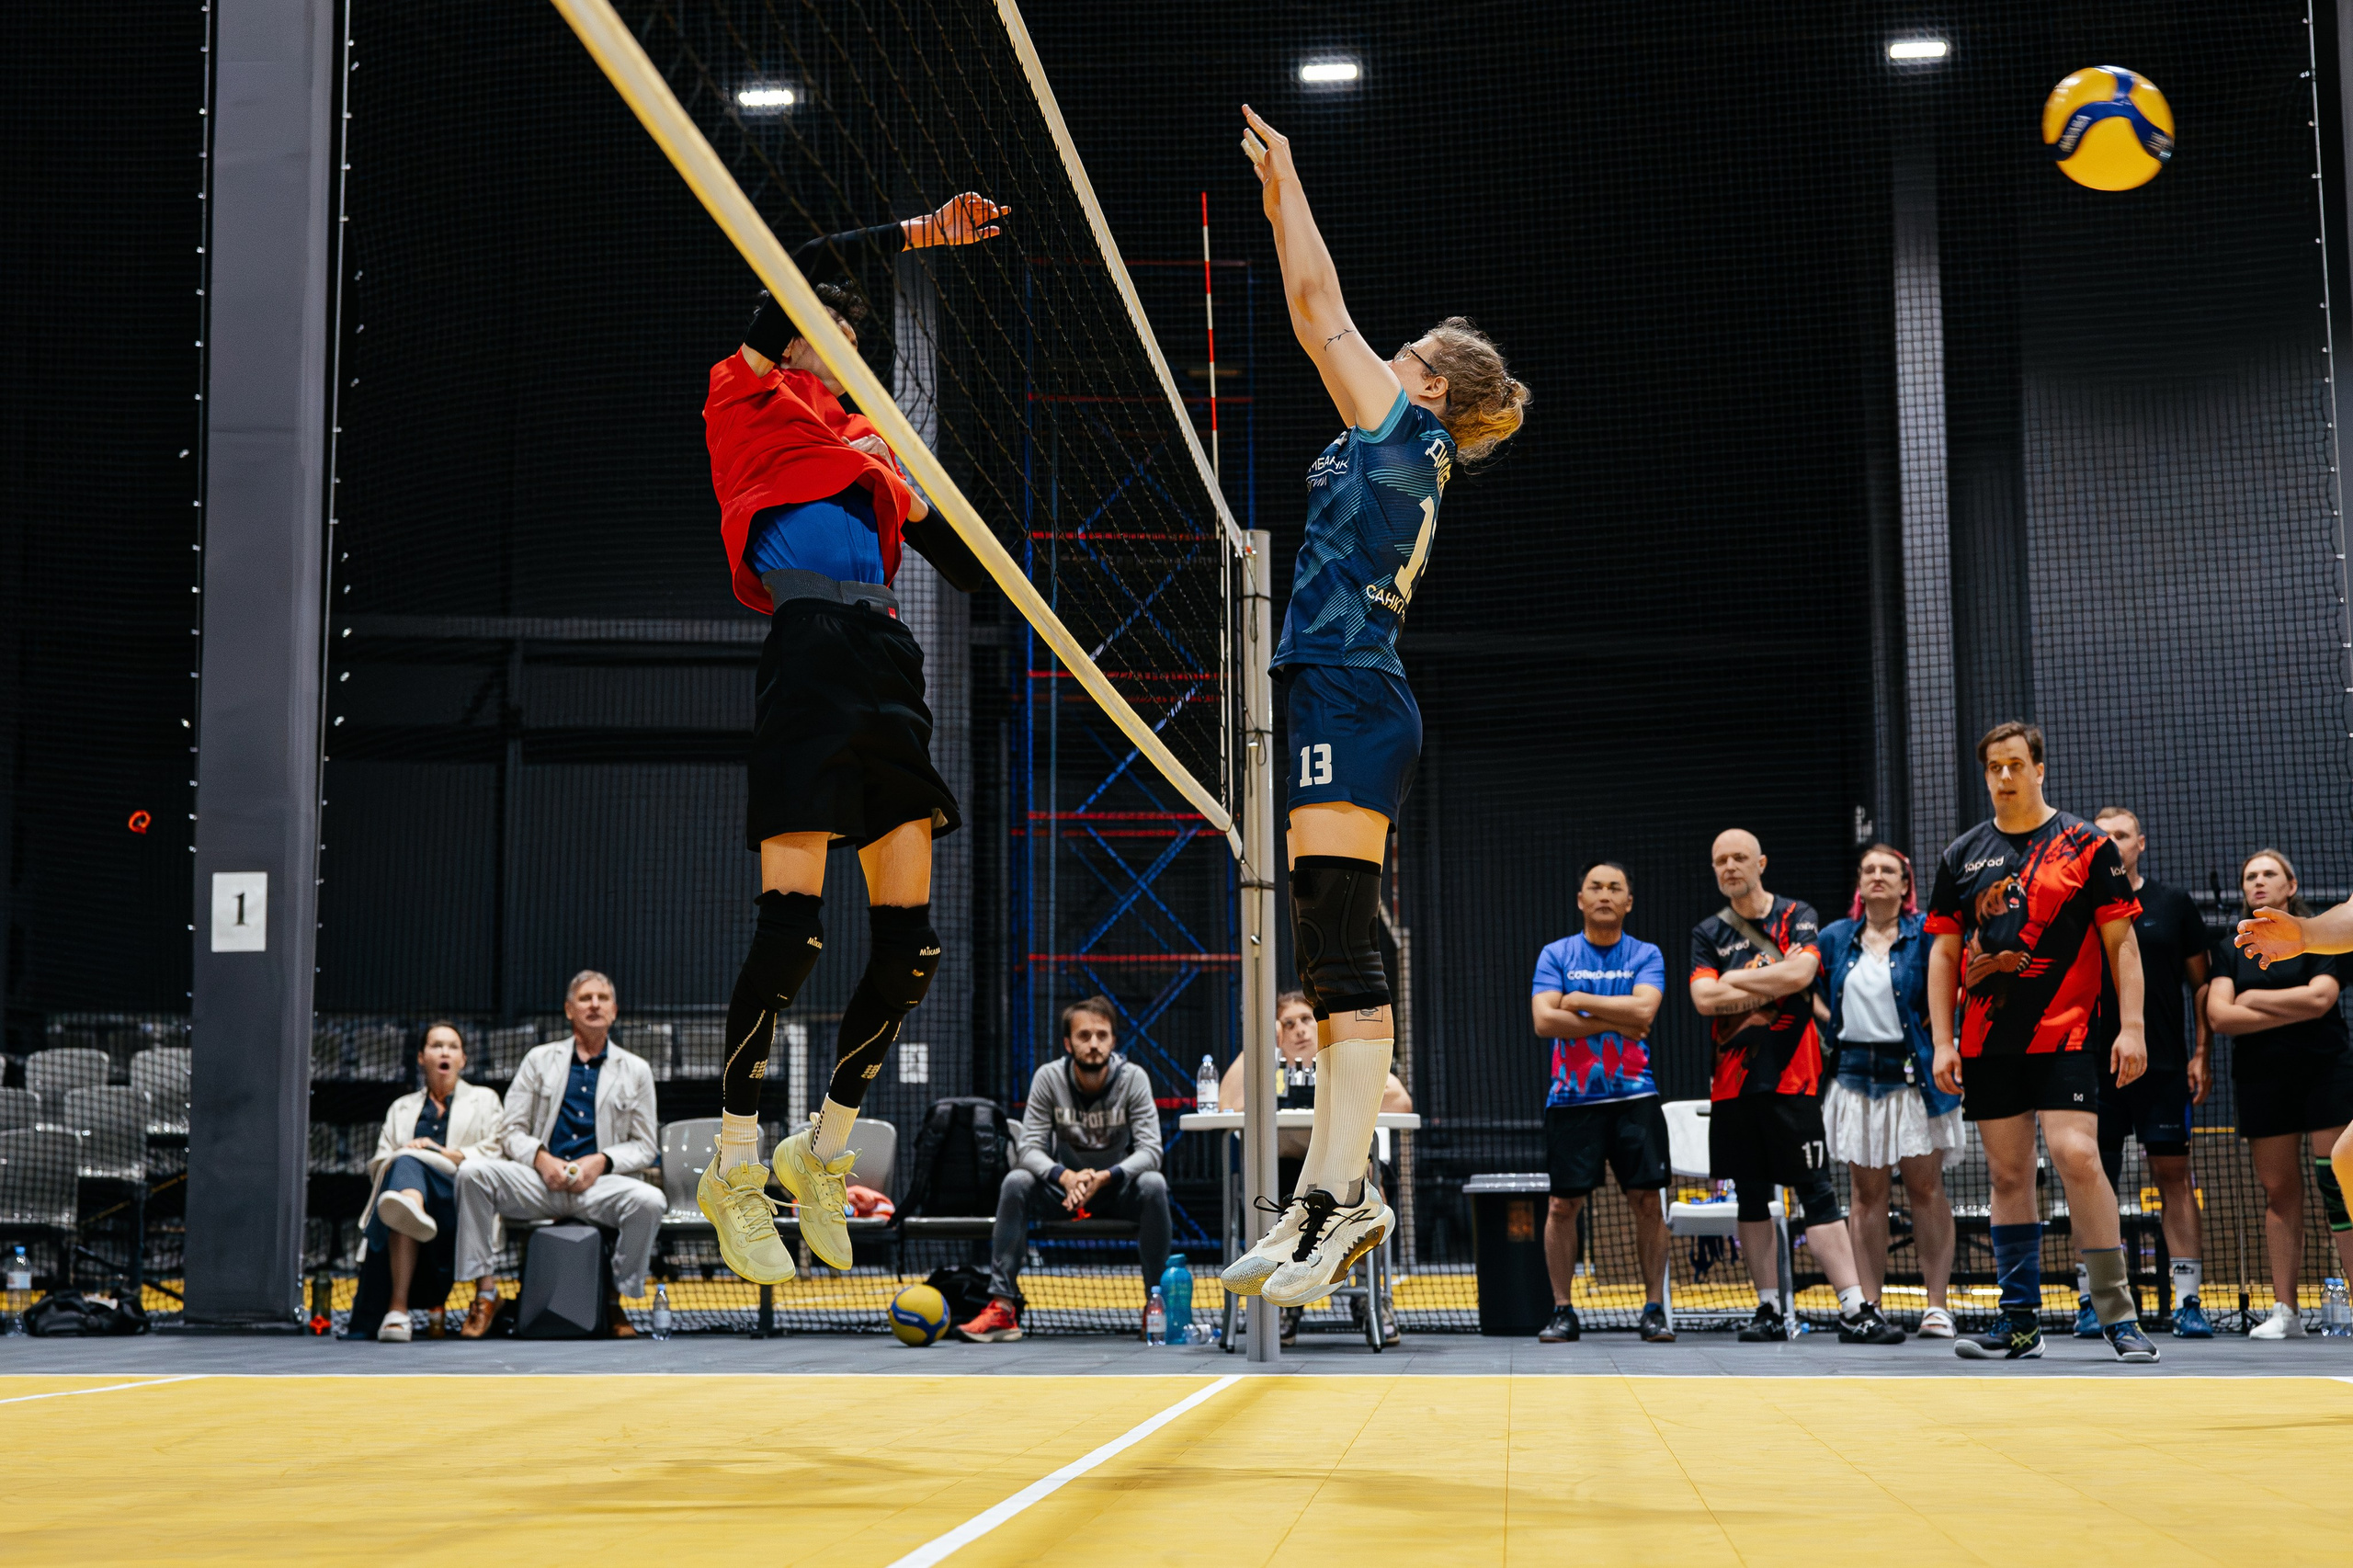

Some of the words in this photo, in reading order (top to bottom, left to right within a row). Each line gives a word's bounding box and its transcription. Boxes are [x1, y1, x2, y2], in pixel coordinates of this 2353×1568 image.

[1300, 744, 1333, 788] 13
[233, 891, 249, 927] 1
[1802, 1141, 1824, 1169] 17
